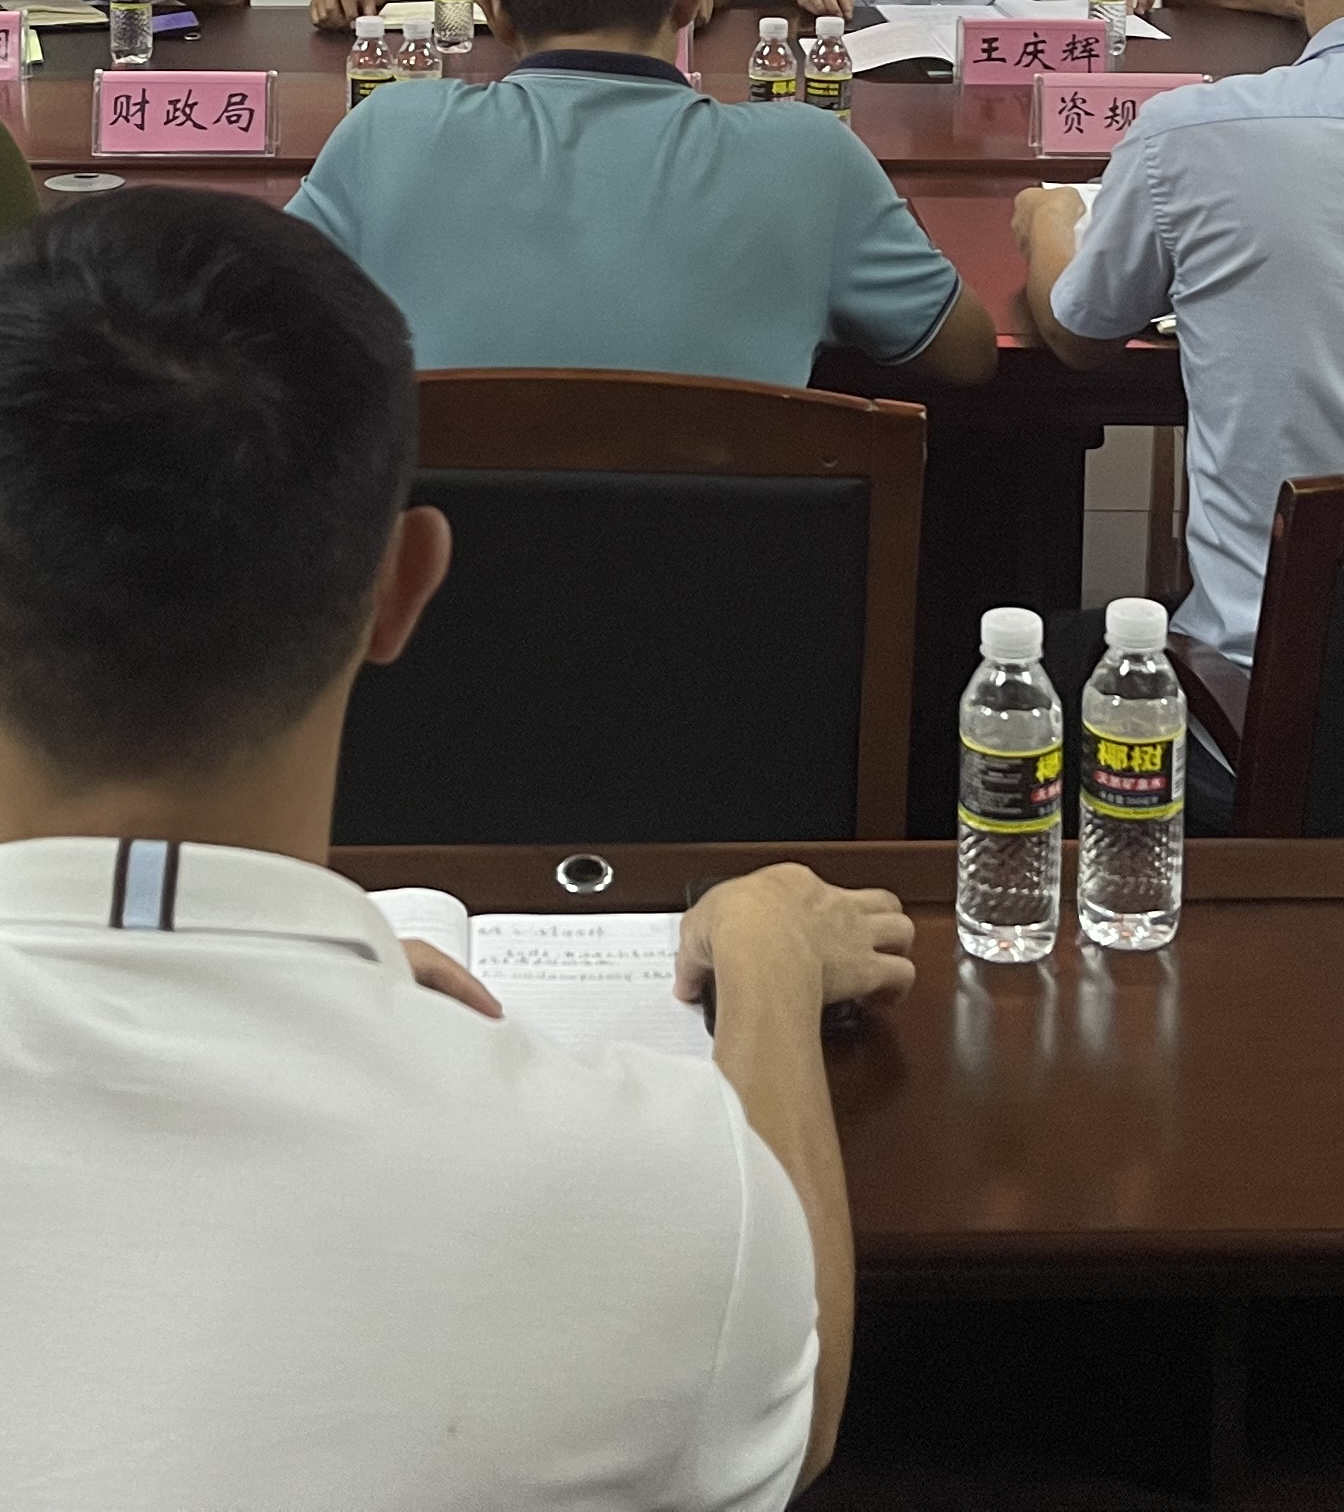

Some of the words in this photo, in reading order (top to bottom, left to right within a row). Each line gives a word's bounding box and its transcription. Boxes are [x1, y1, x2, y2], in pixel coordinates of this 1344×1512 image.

[972, 32, 1100, 73] 王庆辉
[109, 88, 255, 133] 财政局
